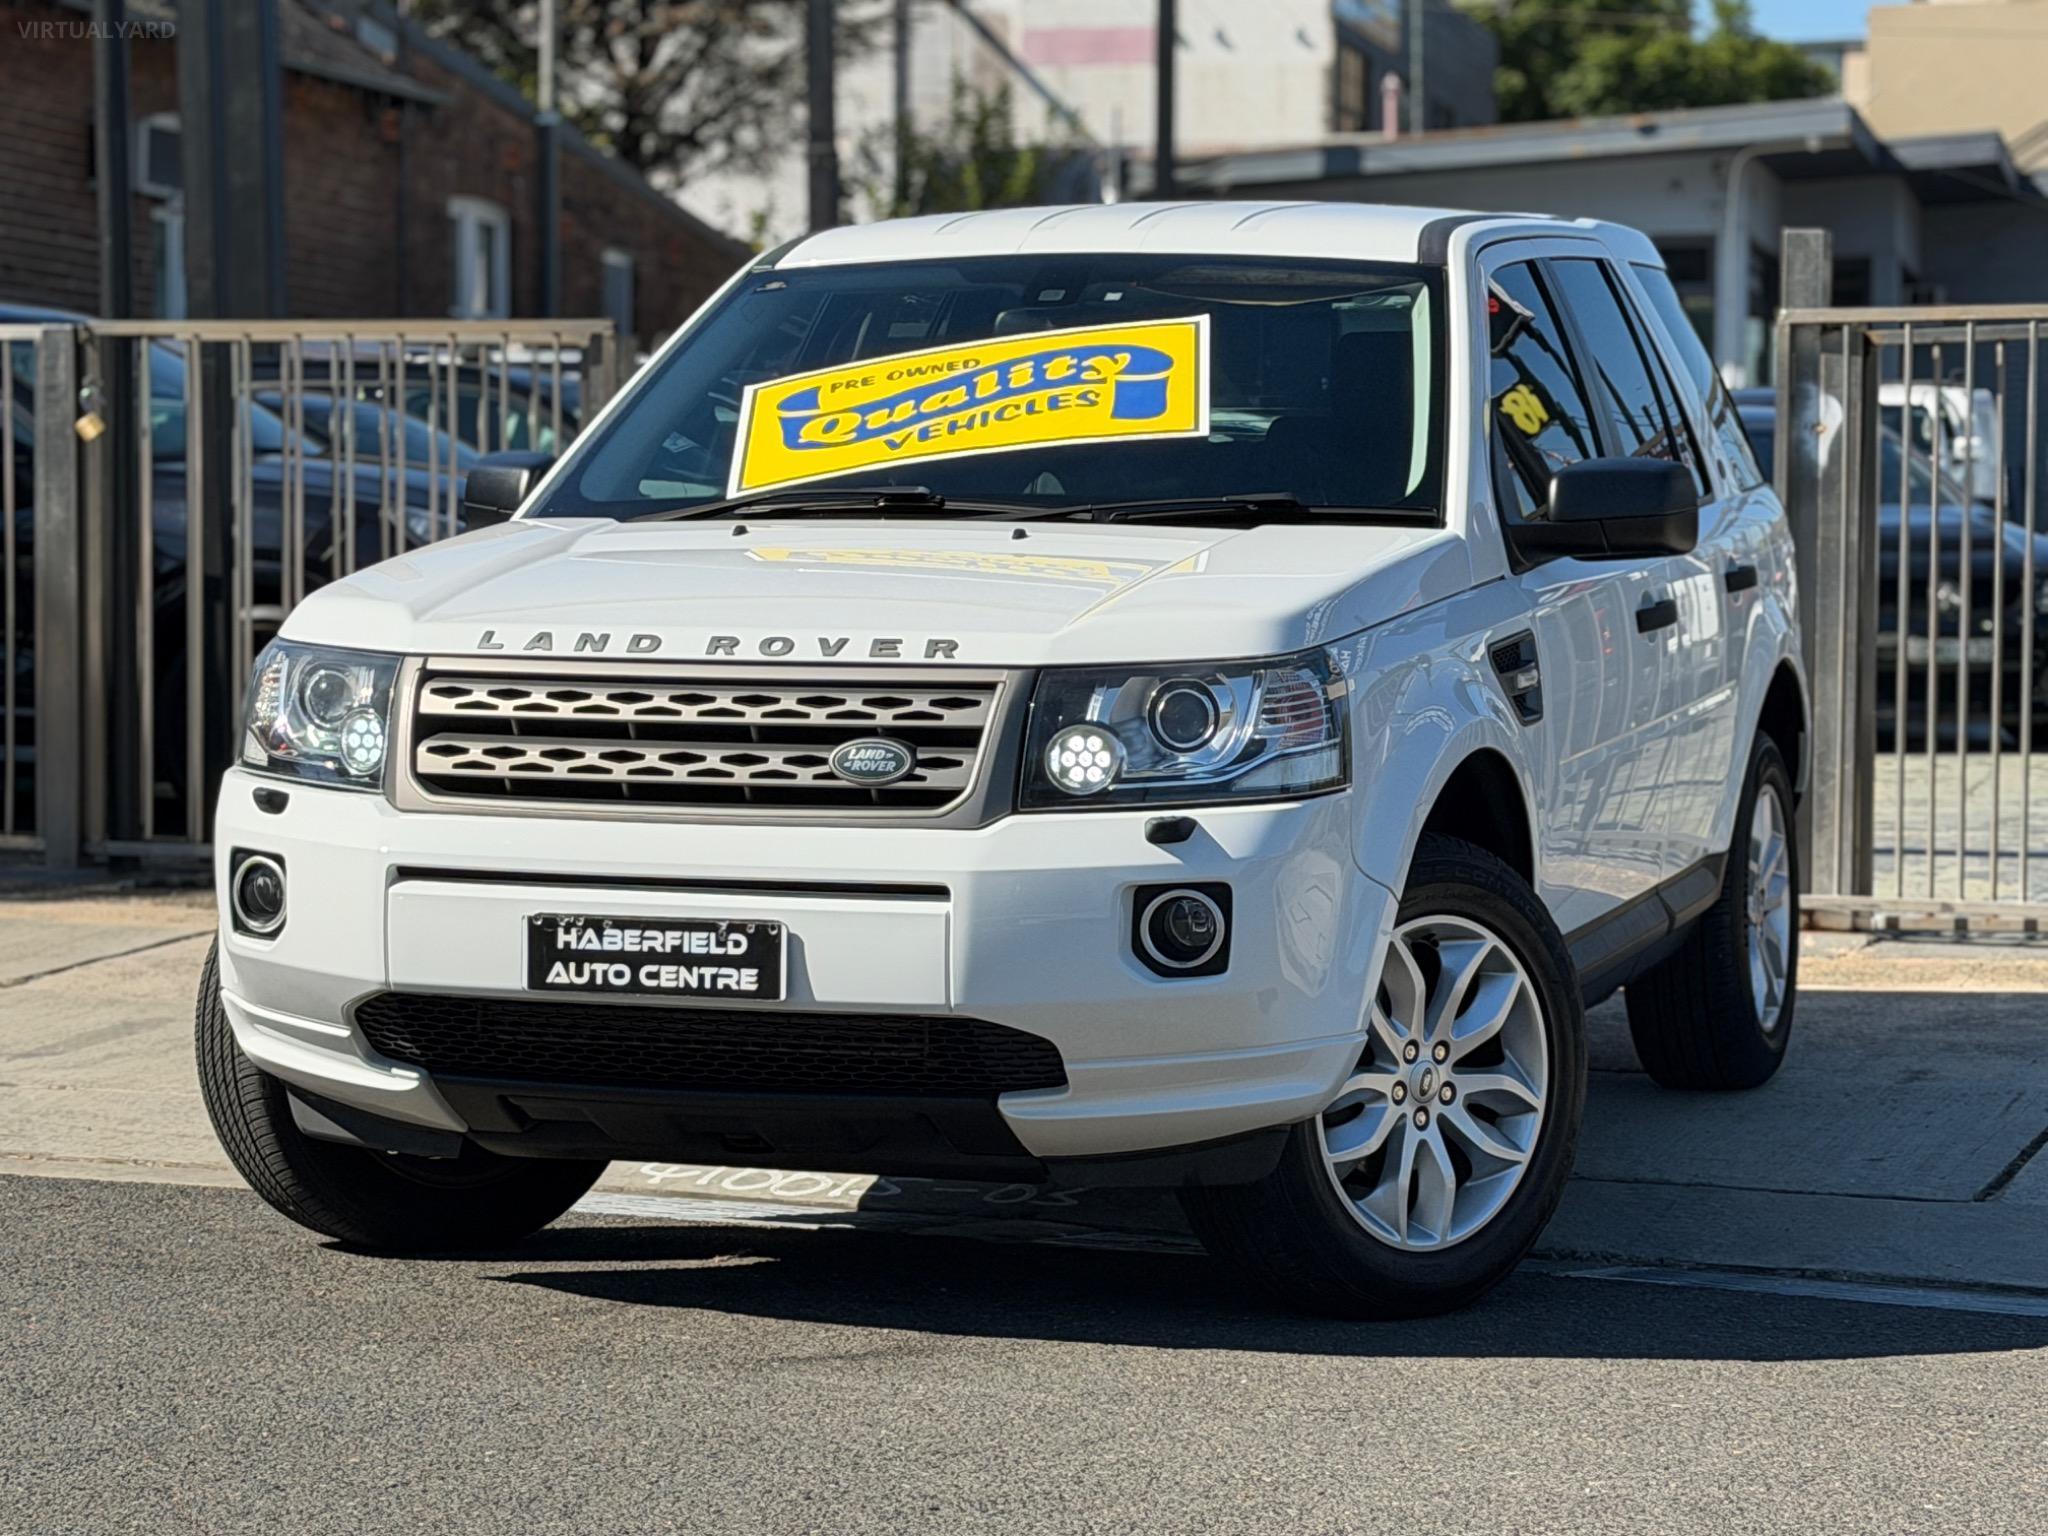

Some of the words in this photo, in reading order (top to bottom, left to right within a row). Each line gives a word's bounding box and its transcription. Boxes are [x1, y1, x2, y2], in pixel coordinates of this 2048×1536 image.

[830, 375, 875, 393] PRE
[886, 358, 981, 381] OWNED
[798, 352, 1131, 443] Quality
[884, 389, 1101, 451] VEHICLES
[477, 630, 662, 653] LAND
[705, 635, 959, 659] ROVER
[848, 748, 886, 760] LAND
[850, 760, 897, 772] ROVER
[556, 927, 748, 955] HABERFIELD
[545, 960, 631, 986] AUTO
[638, 964, 759, 991] CENTRE
